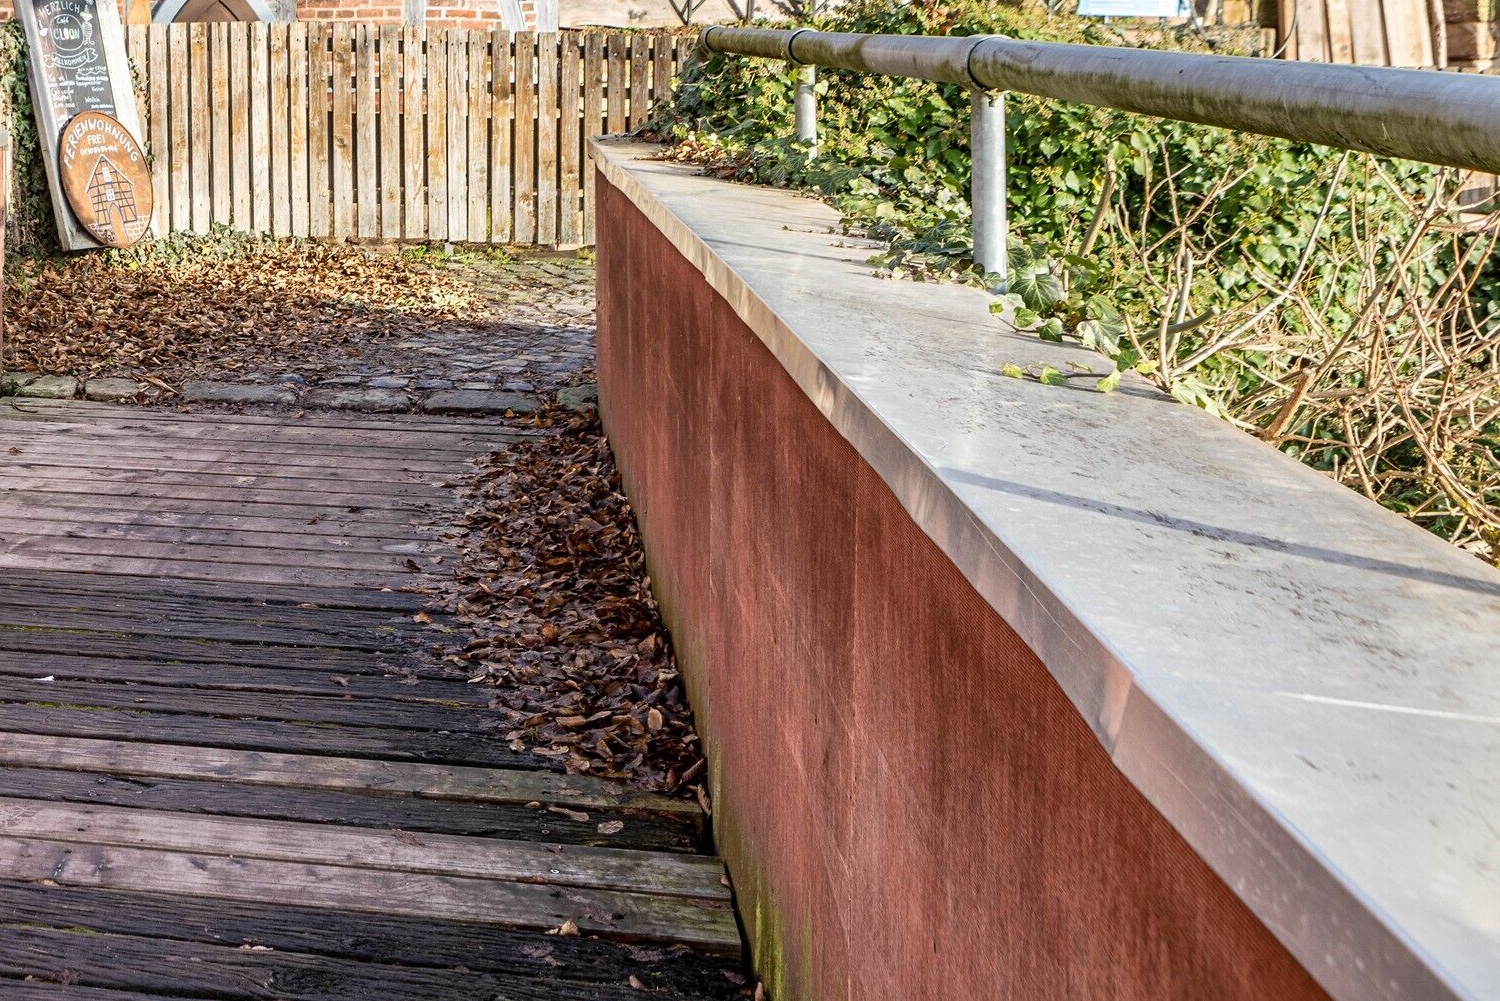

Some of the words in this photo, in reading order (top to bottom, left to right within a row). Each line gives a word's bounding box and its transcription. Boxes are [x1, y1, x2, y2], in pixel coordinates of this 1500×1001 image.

[39, 1, 81, 16] HERZLICH
[53, 28, 80, 41] CLOWN
[52, 54, 87, 67] WILLKOMMEN
[63, 118, 139, 169] FERIENWOHNUNG
[87, 134, 106, 145] FREI
